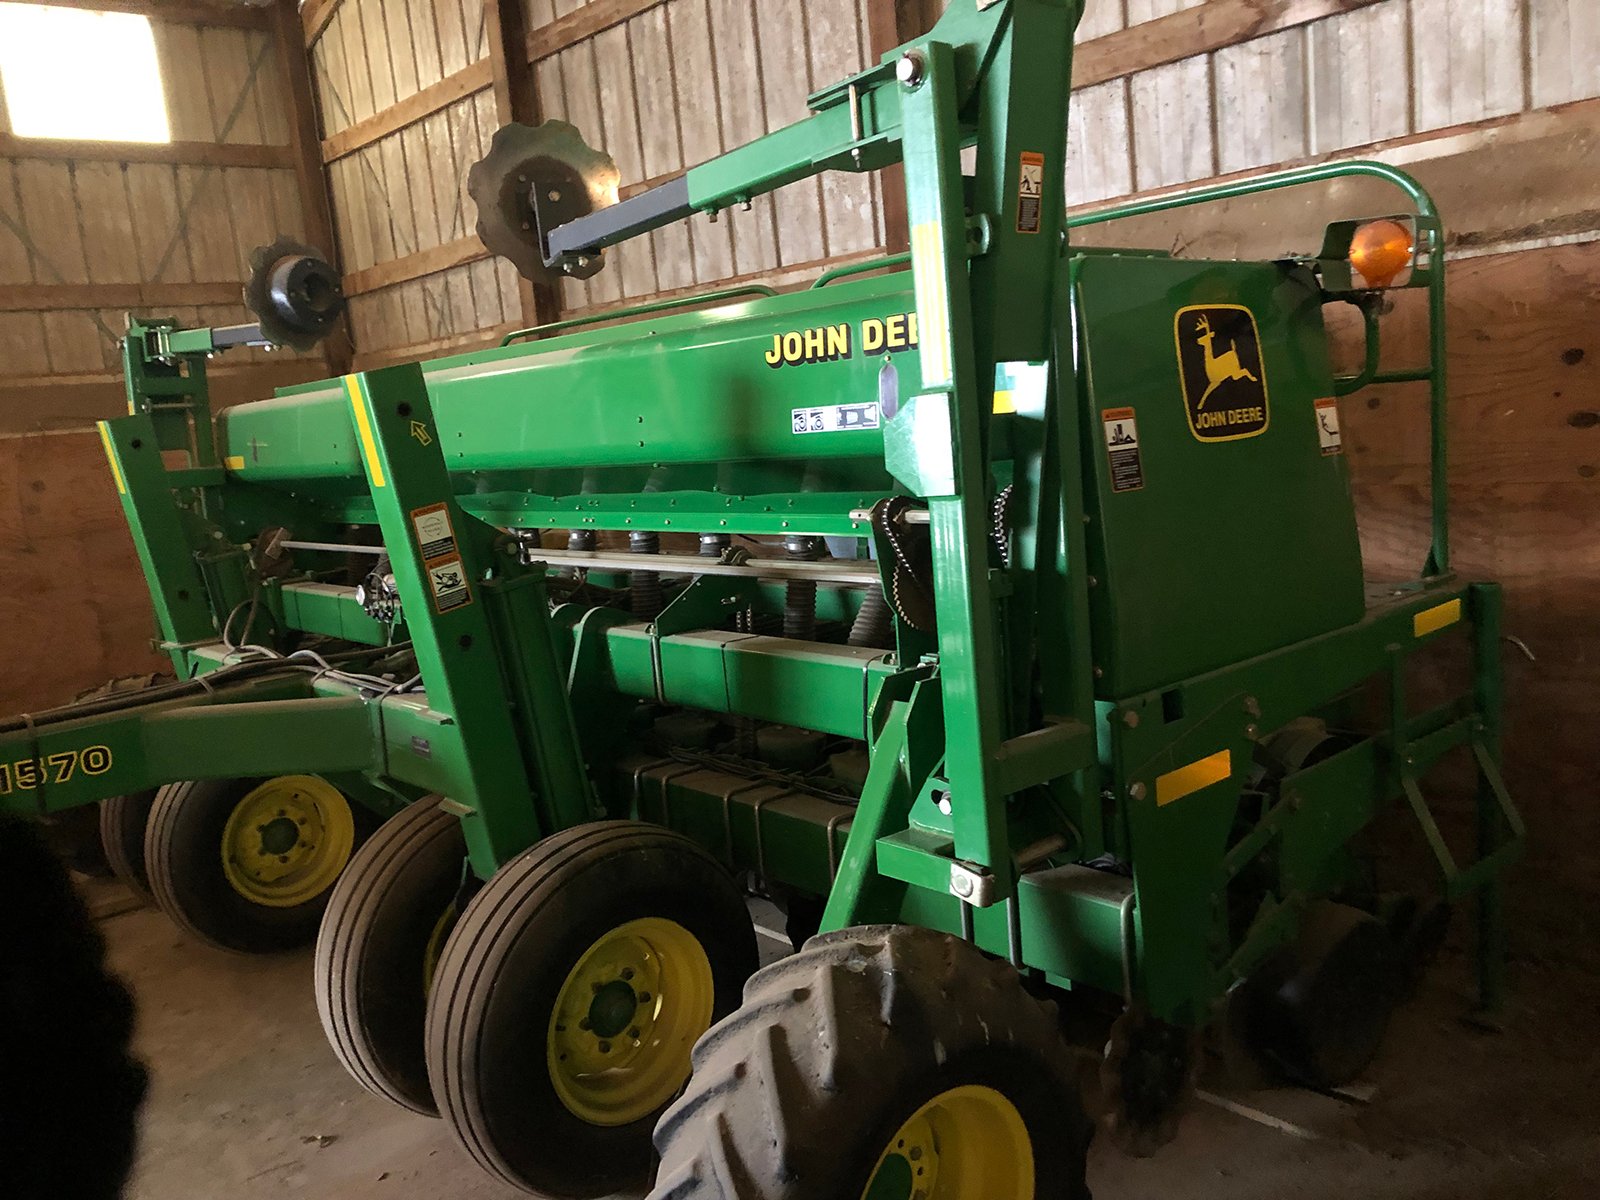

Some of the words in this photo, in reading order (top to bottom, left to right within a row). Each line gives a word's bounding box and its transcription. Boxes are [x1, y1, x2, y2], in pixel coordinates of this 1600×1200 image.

[765, 323, 852, 368] JOHN
[1195, 410, 1227, 430] JOHN
[1228, 406, 1264, 426] DEERE
[0, 745, 112, 794] 1570
